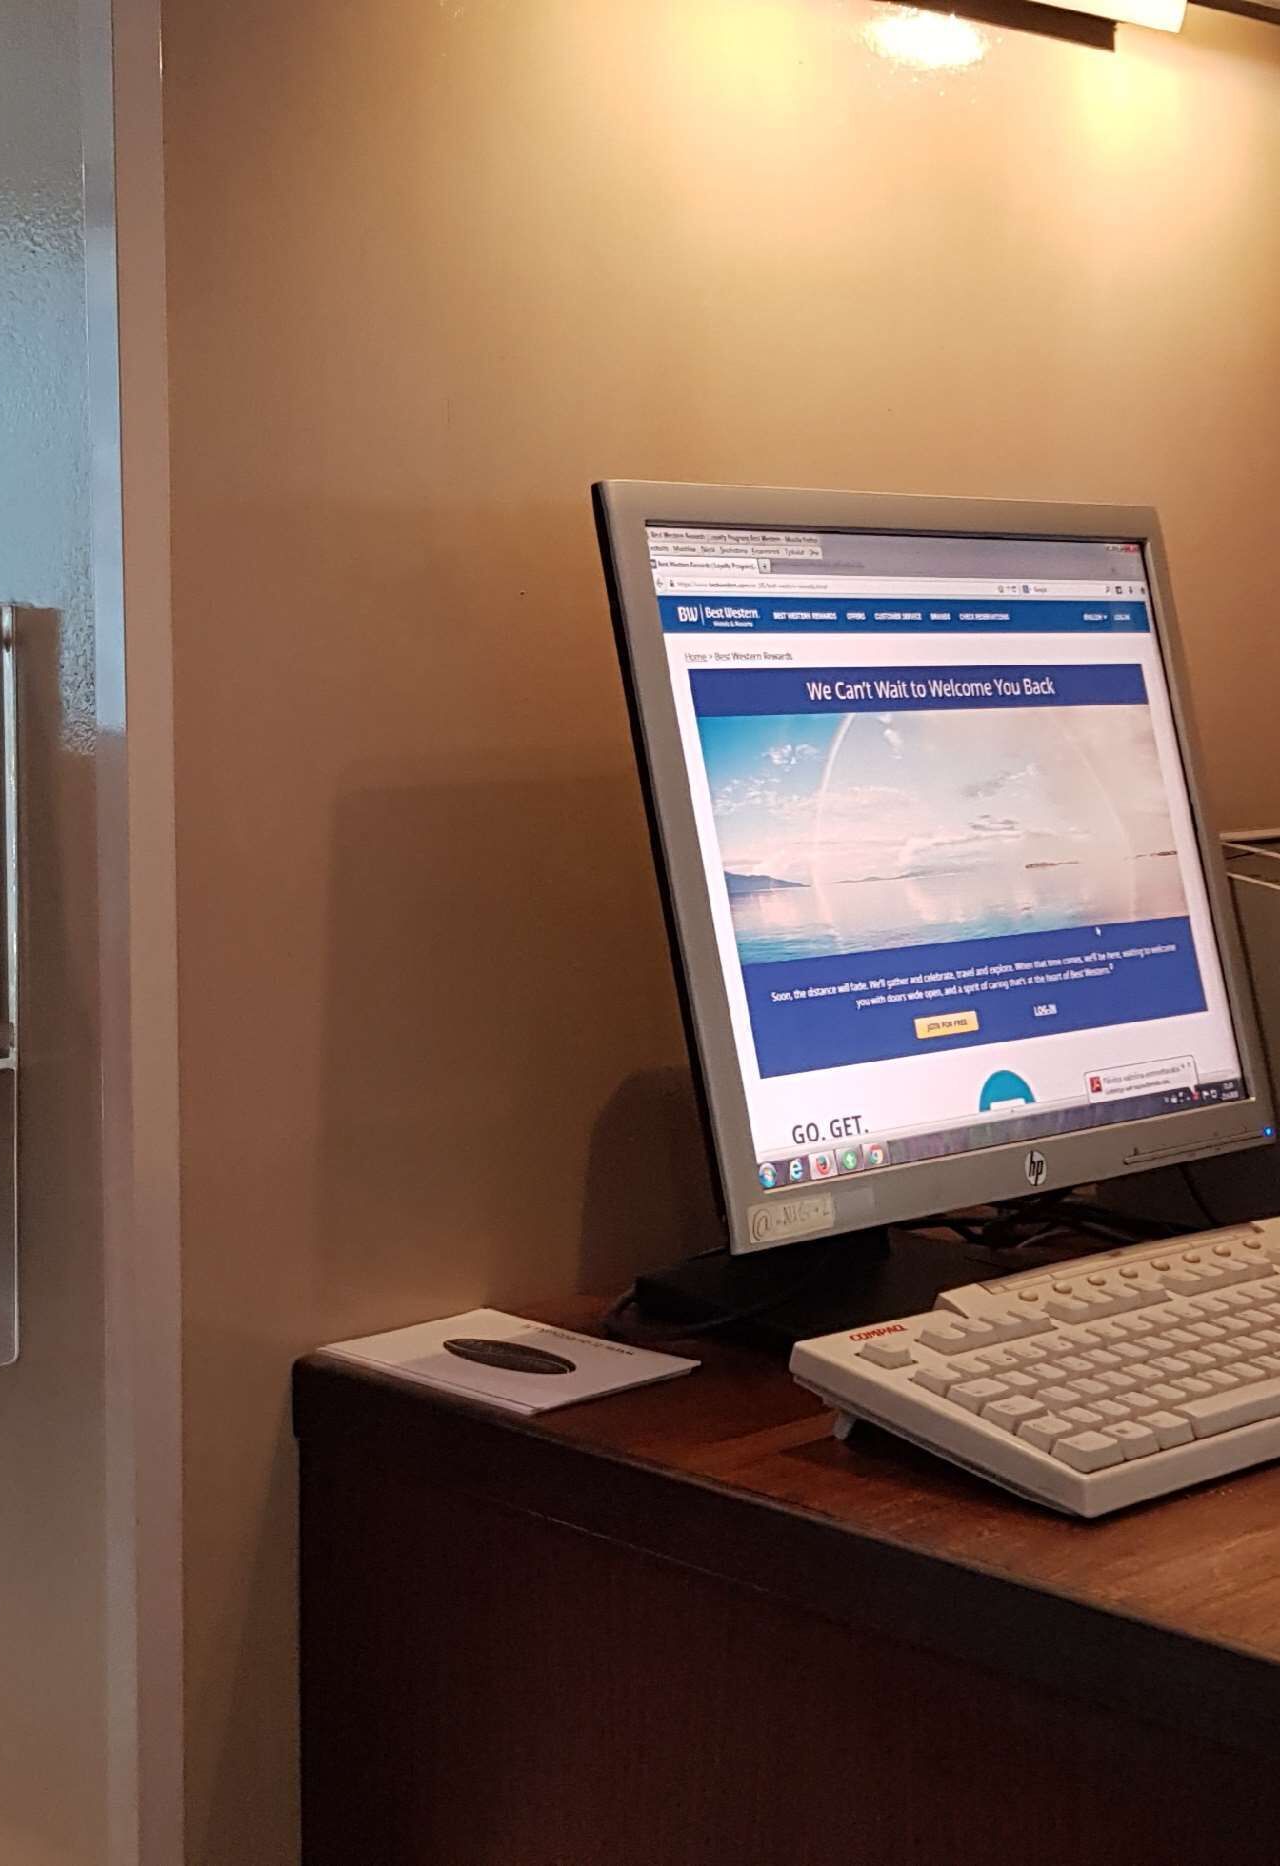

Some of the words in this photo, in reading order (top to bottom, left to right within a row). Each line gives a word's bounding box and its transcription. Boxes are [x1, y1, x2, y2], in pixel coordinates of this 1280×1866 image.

[677, 606, 698, 622] BW
[705, 606, 724, 619] Best
[684, 653, 707, 662] Home
[714, 652, 730, 661] Best
[732, 652, 762, 661] Western
[763, 652, 793, 661] Rewards
[806, 682, 832, 701] We
[834, 681, 872, 700] Can't
[873, 680, 909, 699] Wait
[910, 680, 926, 698] to
[928, 678, 992, 698] Welcome
[993, 678, 1020, 696] You
[1022, 676, 1055, 695] Back
[770, 991, 793, 1003] Soon,
[793, 988, 807, 999] the
[807, 986, 836, 998] distance
[837, 982, 850, 993] will
[850, 981, 869, 993] fade.
[869, 978, 886, 989] We'll
[886, 975, 909, 989] gather
[910, 973, 923, 985] and
[956, 967, 975, 979] travel
[975, 964, 989, 976] and
[1014, 961, 1033, 971] When
[1033, 959, 1047, 970] that
[1047, 957, 1062, 968] time
[1097, 951, 1106, 962] be
[1122, 947, 1144, 959] waiting
[1144, 946, 1152, 956] to
[1151, 943, 1176, 955] welcome
[856, 998, 870, 1010] you
[870, 995, 887, 1006] with
[887, 992, 907, 1004] doors
[907, 989, 924, 1001] wide
[943, 984, 957, 996] and
[957, 986, 963, 995] a
[963, 981, 980, 995] spirit
[980, 979, 988, 991] of
[988, 978, 1009, 991] caring
[1009, 975, 1027, 987] that's
[1027, 976, 1034, 985] at
[1033, 974, 1045, 985] the
[1045, 971, 1063, 983] heart
[1063, 970, 1070, 981] of
[1070, 968, 1084, 980] Best
[941, 1021, 953, 1029] FOR
[953, 1018, 968, 1028] FREE
[791, 1122, 826, 1144] GO.
[829, 1115, 869, 1139] GET.
[1028, 1150, 1044, 1187] hp
[848, 1323, 908, 1342] COMPAQ
